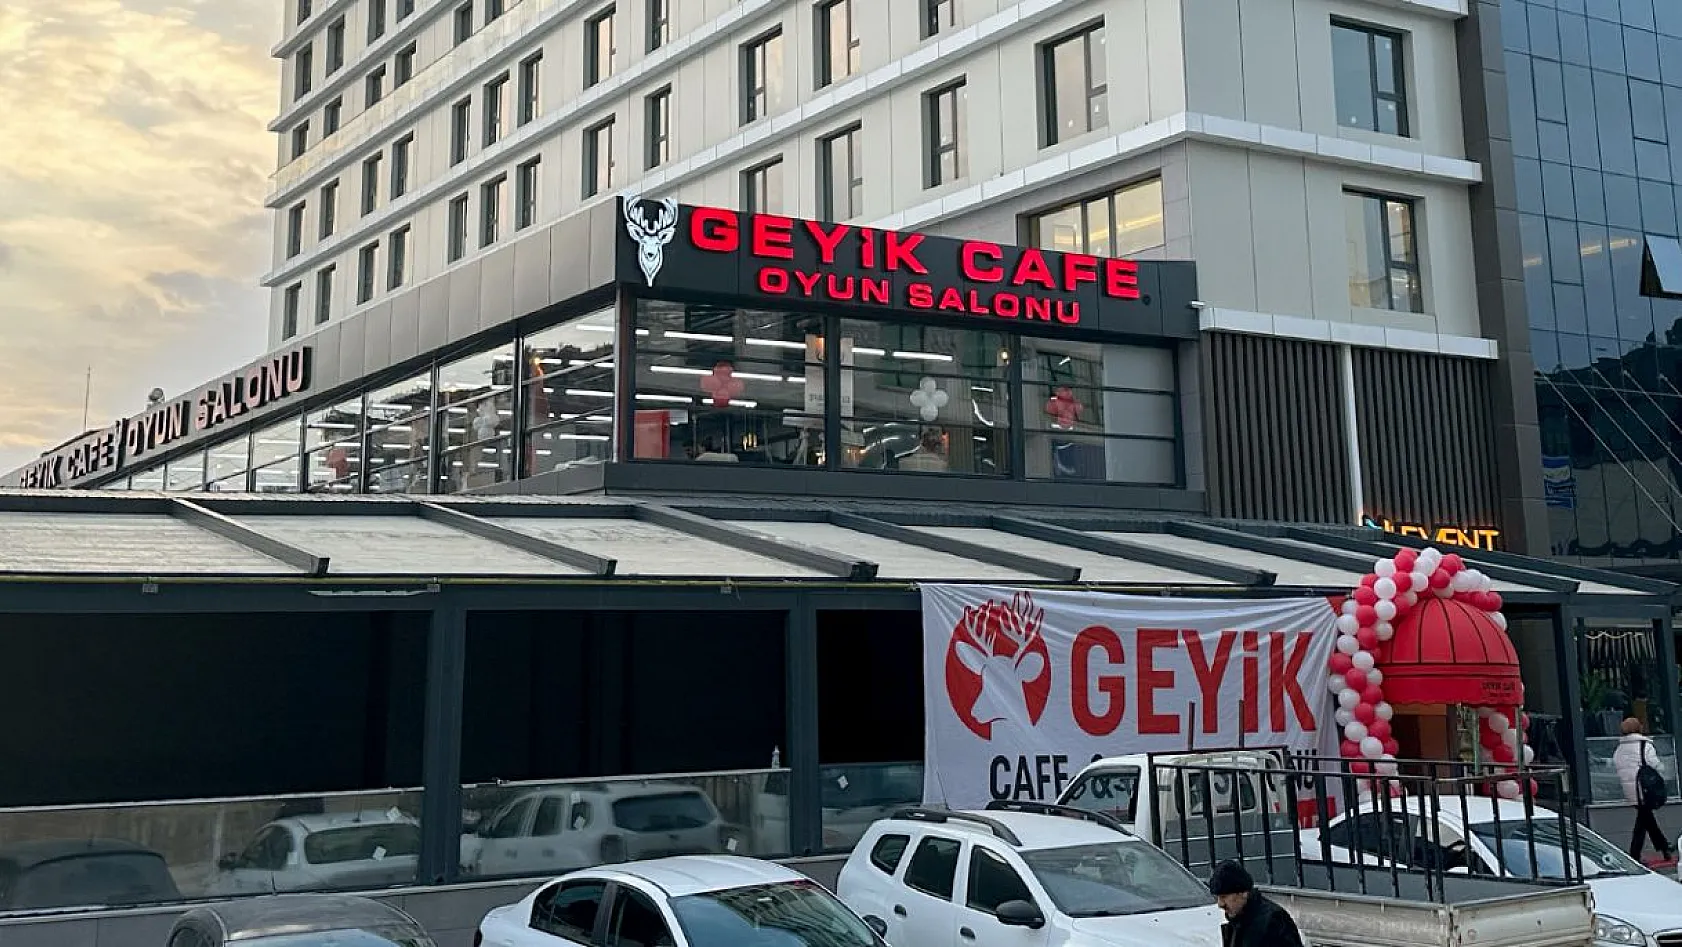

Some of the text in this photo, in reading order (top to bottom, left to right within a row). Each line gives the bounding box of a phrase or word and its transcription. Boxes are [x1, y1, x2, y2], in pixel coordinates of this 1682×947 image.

[759, 267, 1080, 324] OYUN SALONU
[962, 239, 1140, 299] CAFE
[67, 433, 115, 480] CAFE
[126, 399, 191, 456] OYUN
[195, 346, 312, 430] SALONU
